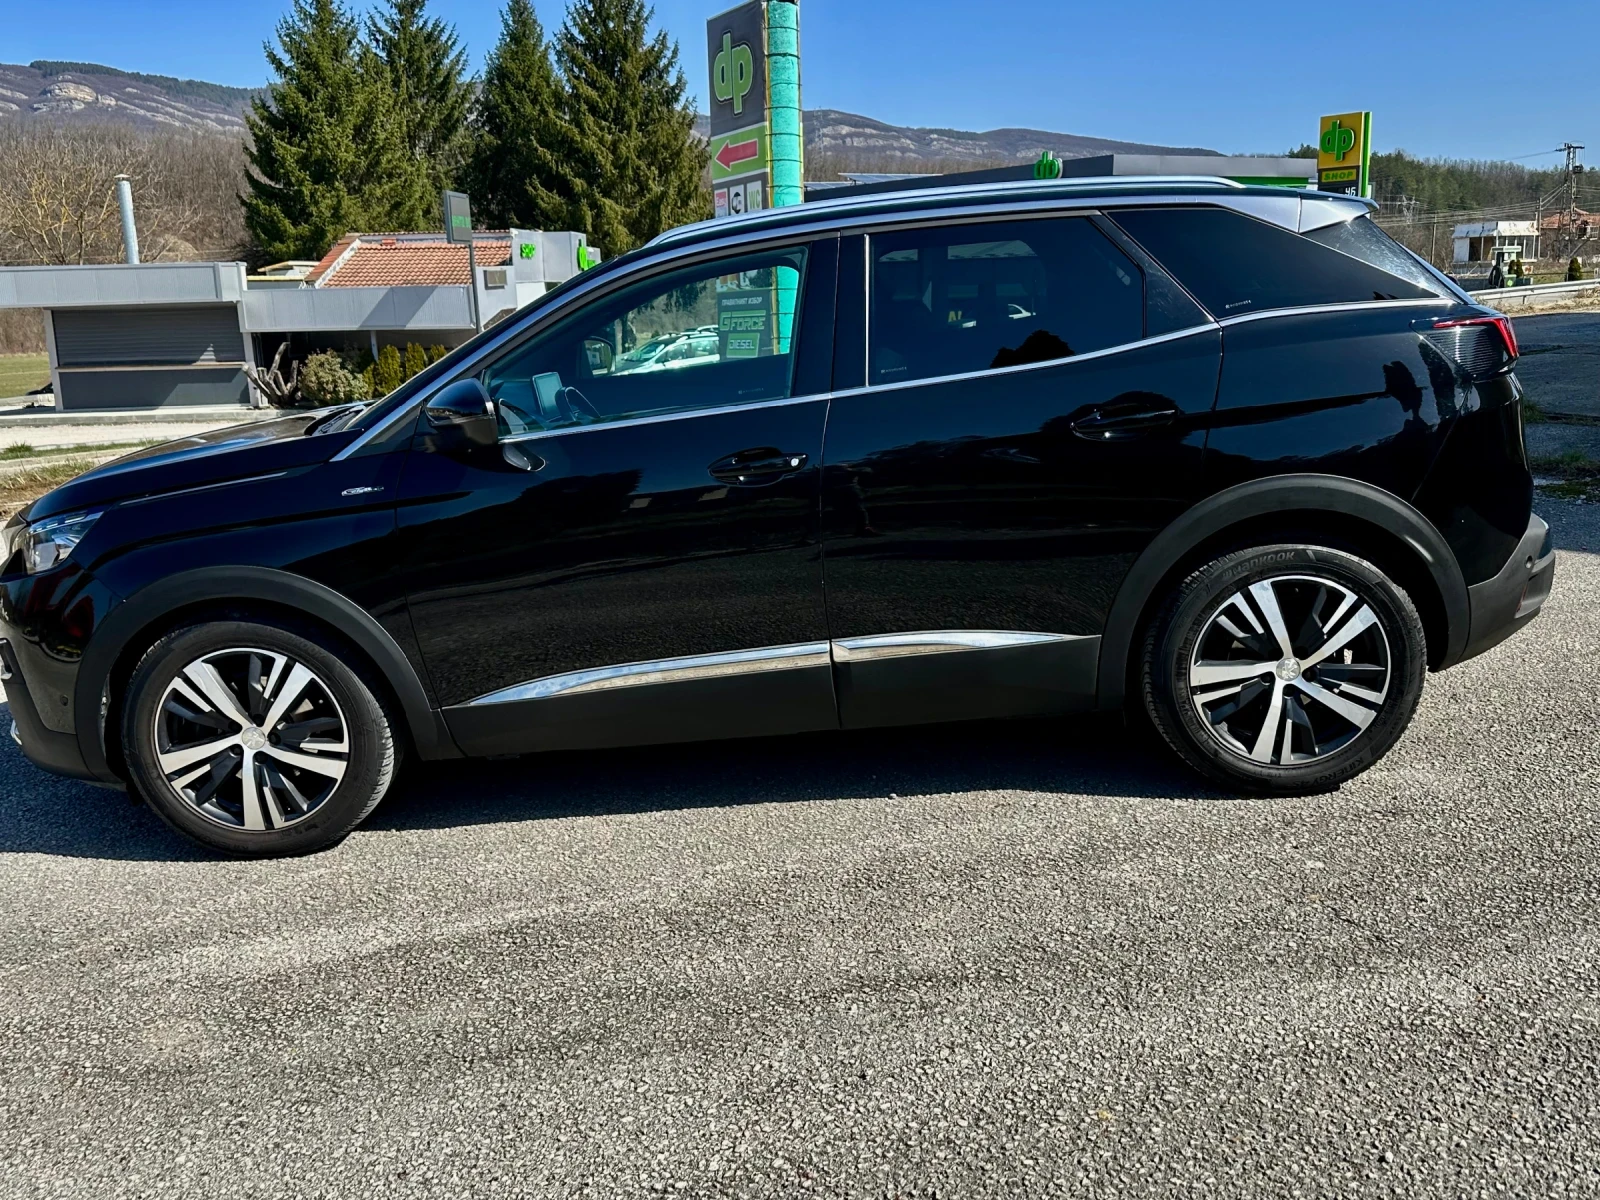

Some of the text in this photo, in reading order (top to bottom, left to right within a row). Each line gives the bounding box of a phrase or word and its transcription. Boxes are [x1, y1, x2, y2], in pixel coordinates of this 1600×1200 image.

[713, 31, 754, 115] dp
[1320, 120, 1355, 162] dp
[1323, 171, 1354, 181] SHOP
[748, 189, 761, 209] WC
[729, 339, 755, 349] DIESEL
